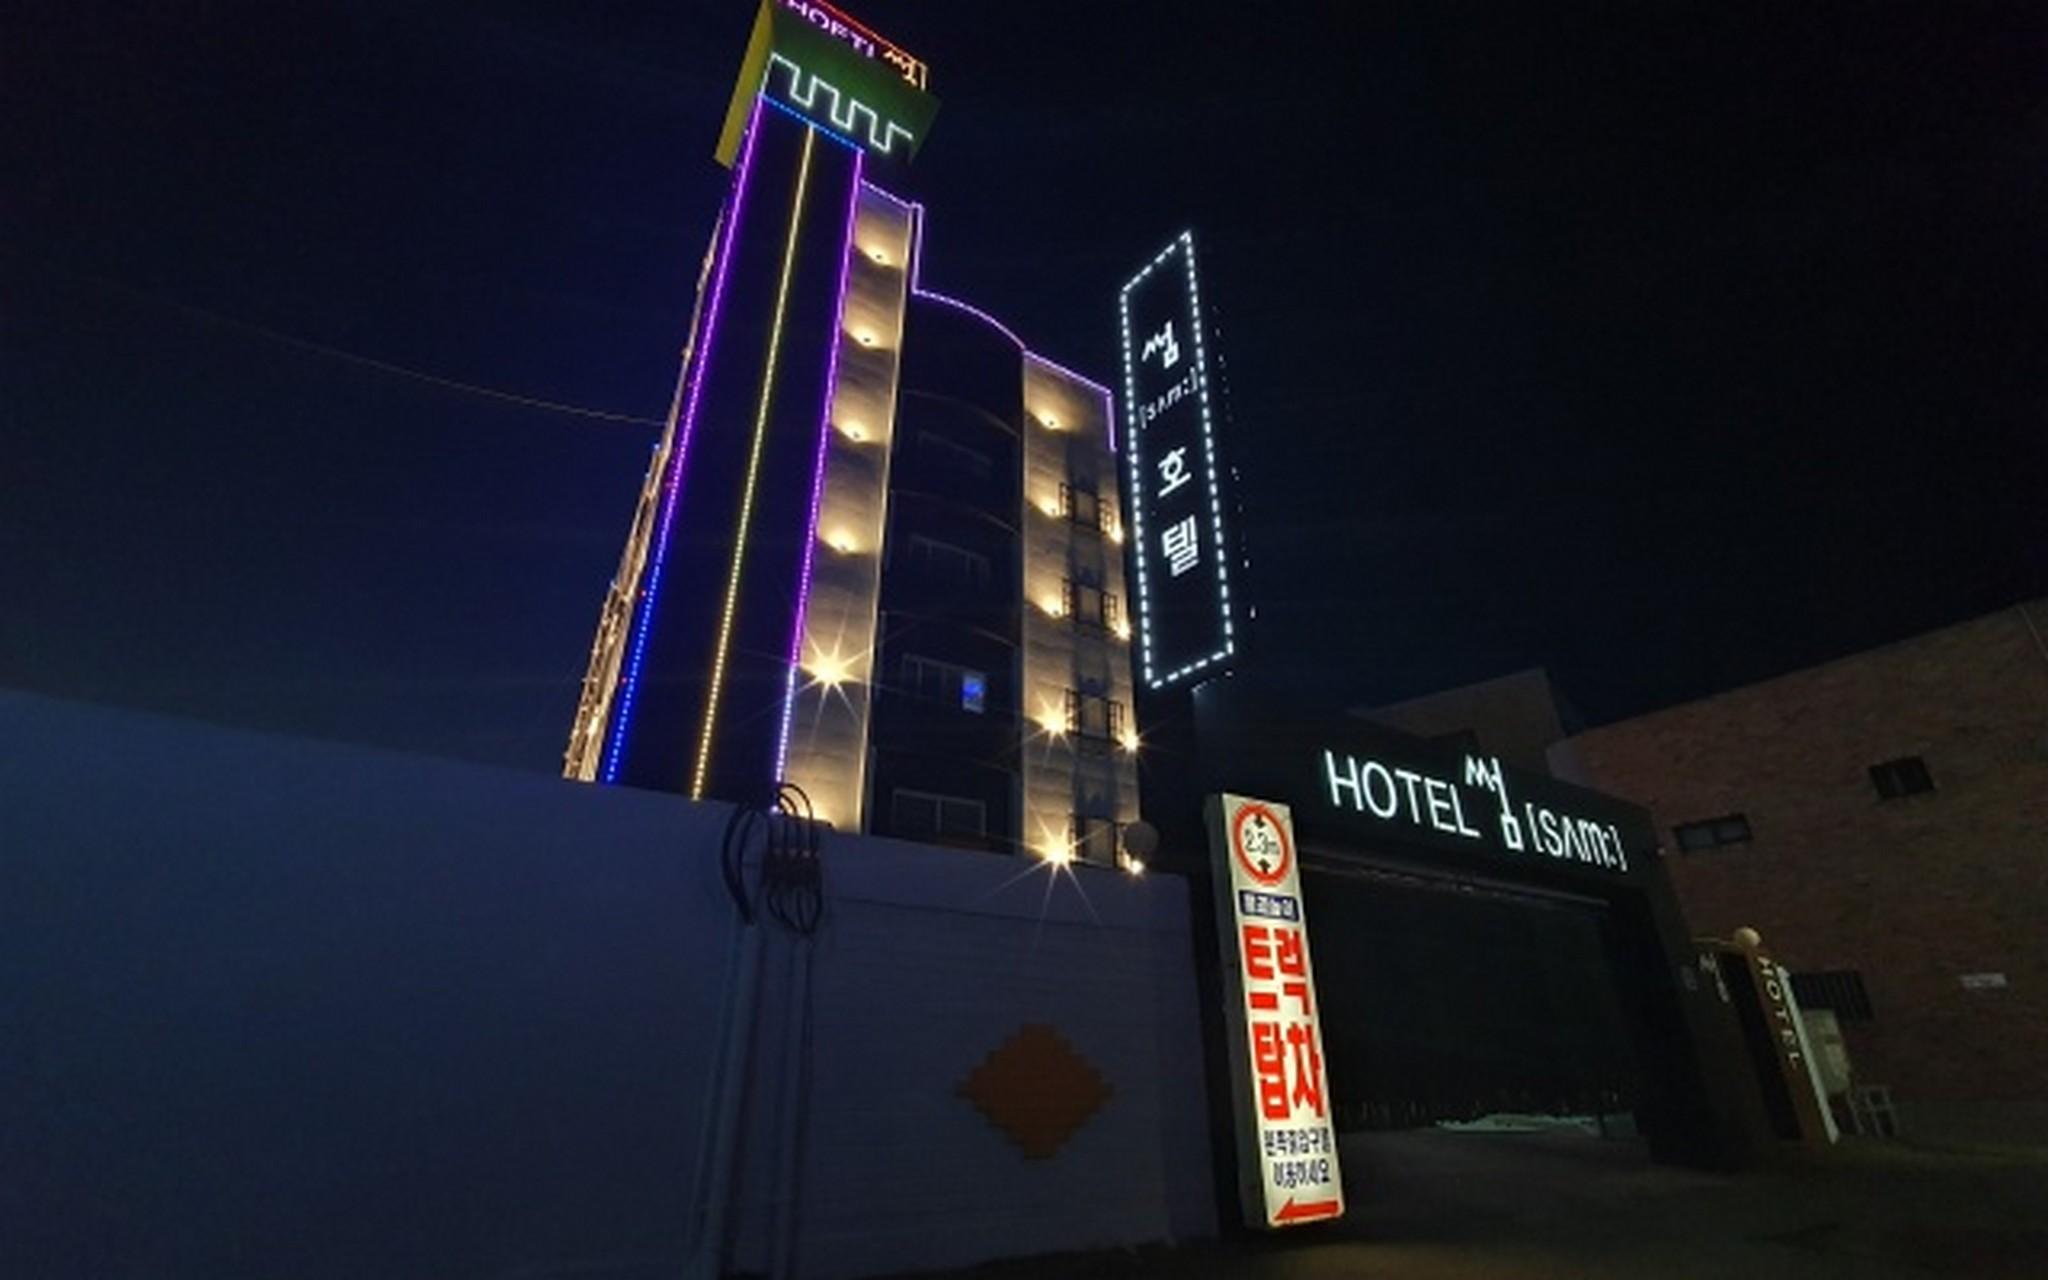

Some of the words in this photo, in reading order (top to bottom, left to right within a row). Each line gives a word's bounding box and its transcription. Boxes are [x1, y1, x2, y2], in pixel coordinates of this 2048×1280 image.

[1157, 446, 1199, 577] 호텔
[1325, 749, 1481, 838] HOTEL
[1242, 924, 1311, 1016] 트럭
[1757, 956, 1800, 1069] HOTEL
[1252, 1021, 1325, 1120] 탑차
